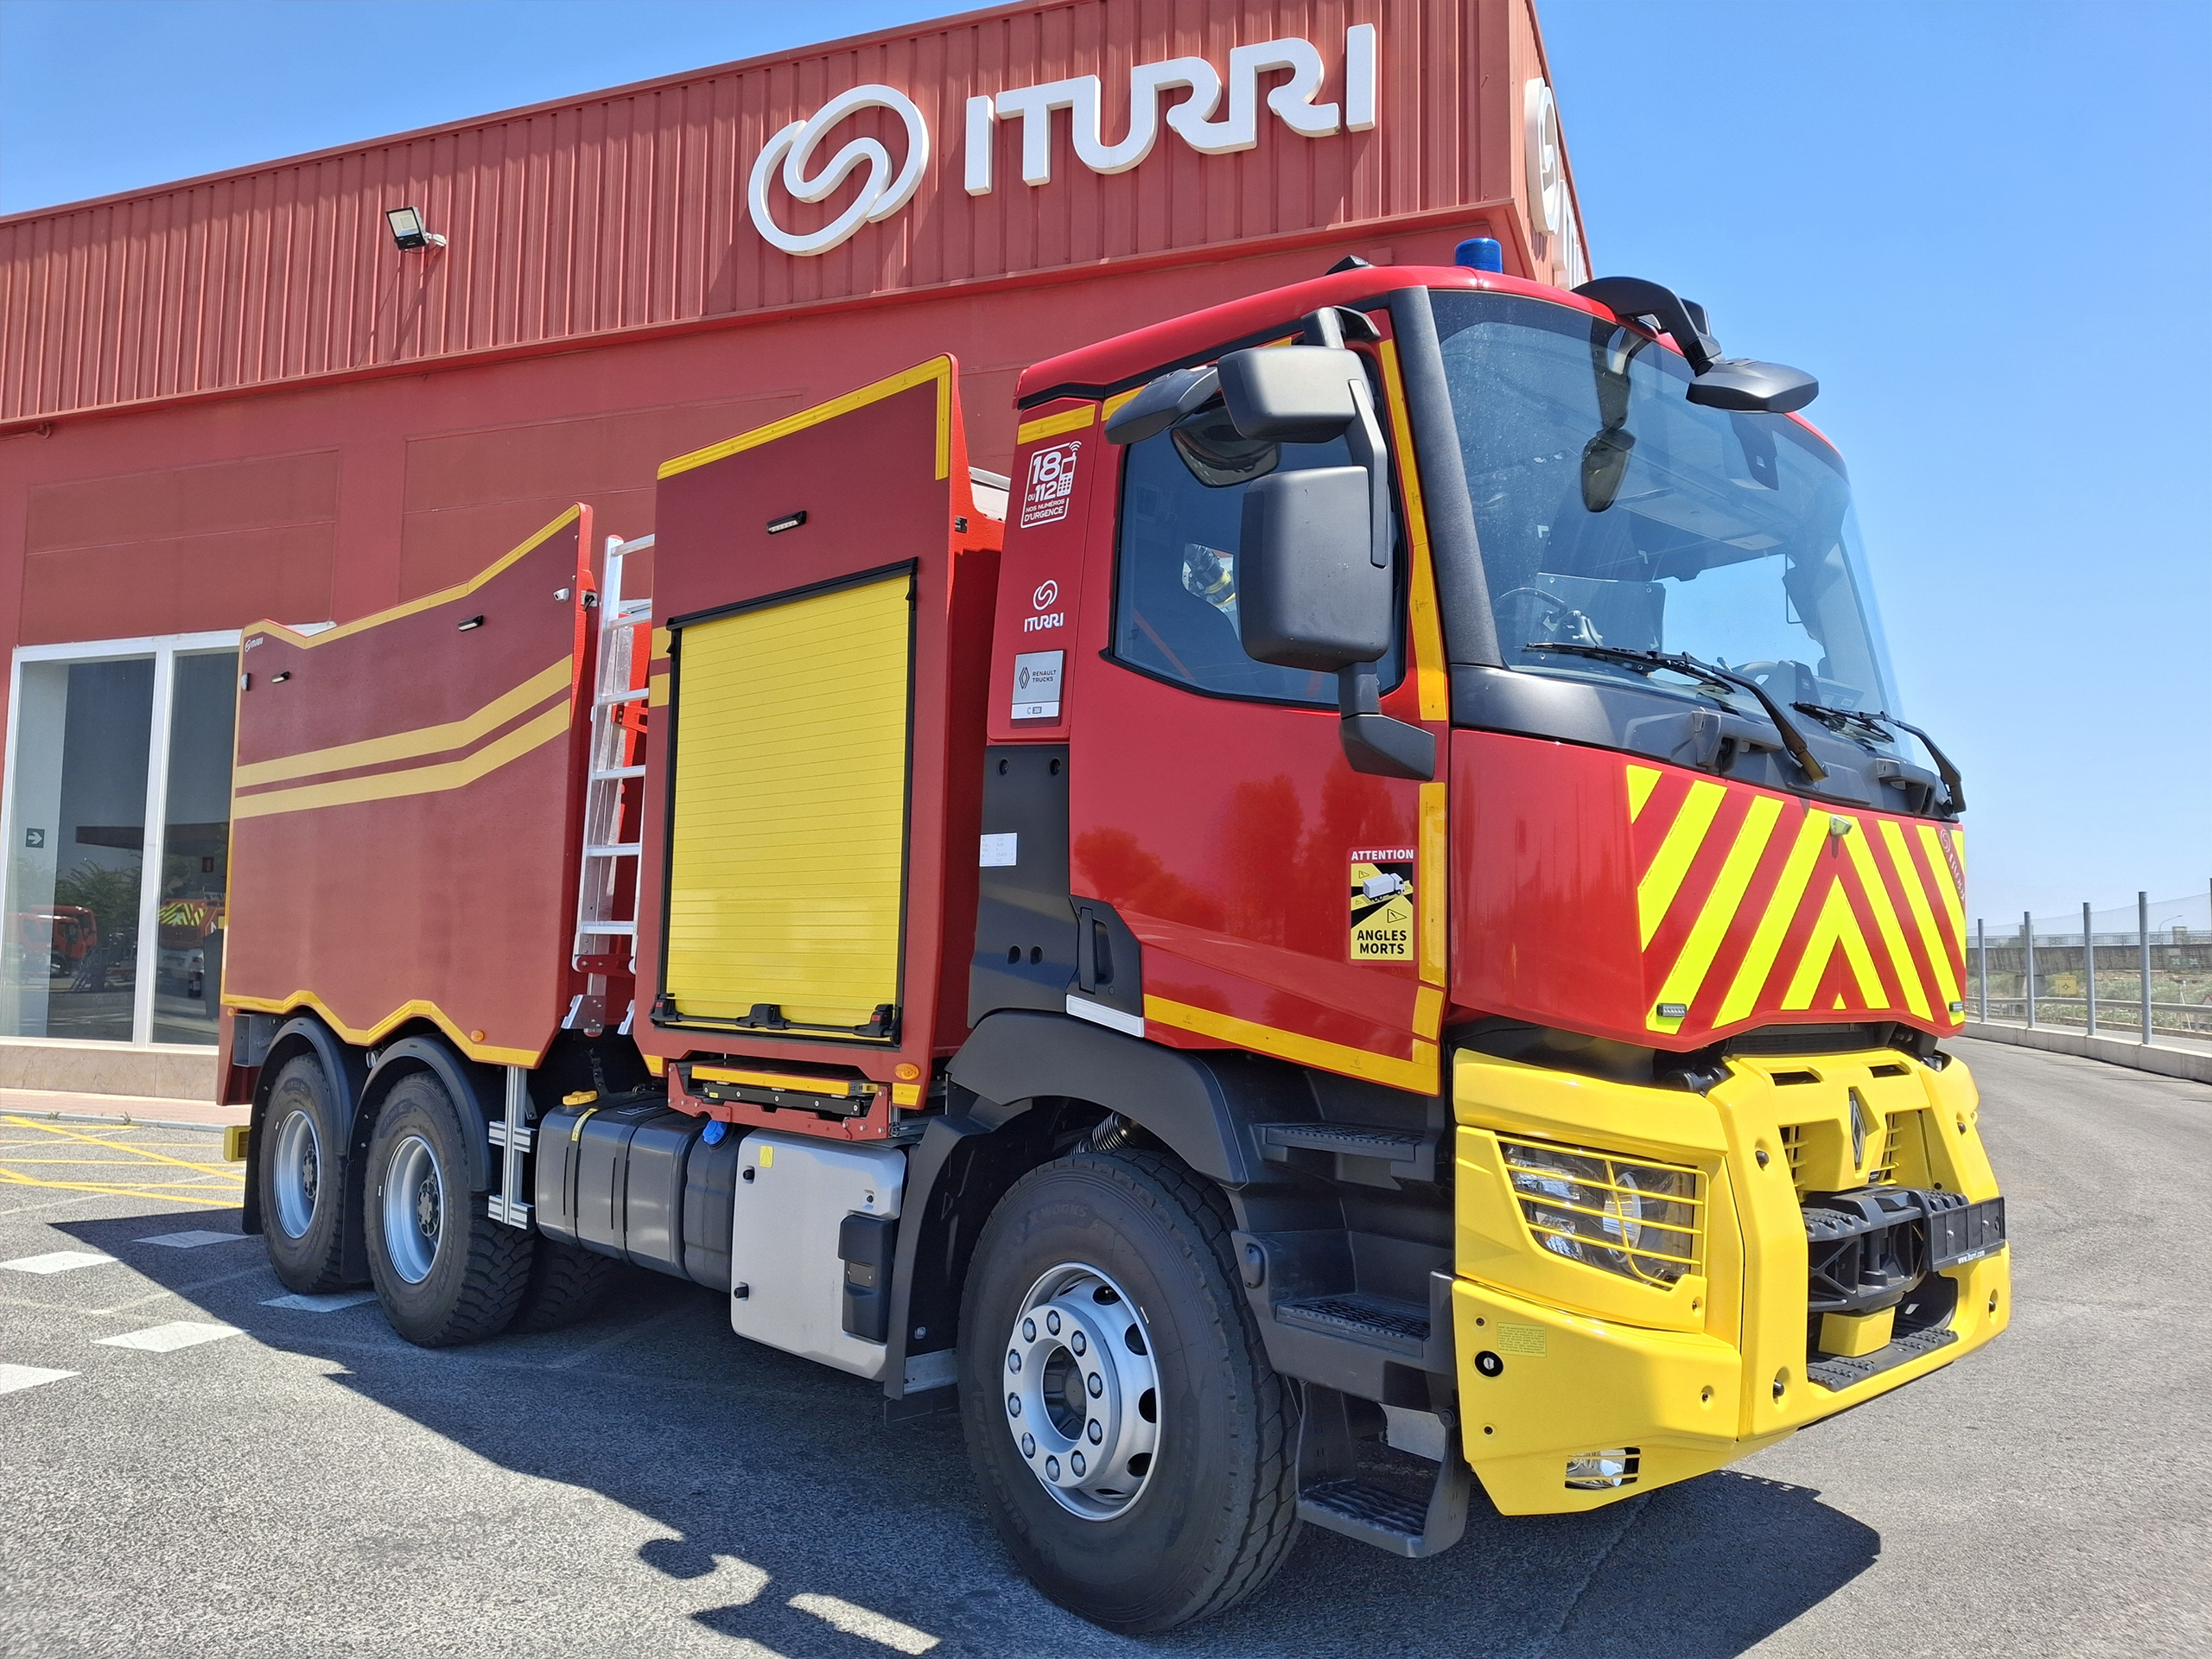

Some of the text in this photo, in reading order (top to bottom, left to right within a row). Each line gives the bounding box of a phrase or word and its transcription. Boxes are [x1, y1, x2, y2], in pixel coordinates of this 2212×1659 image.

[964, 23, 1376, 196] ITURRI
[1033, 451, 1062, 484] 18
[1034, 481, 1058, 502] 112
[1038, 499, 1065, 510] NUMÉROS
[1024, 506, 1064, 522] D'URGENCE
[1024, 612, 1064, 632] ITURRI
[1351, 849, 1414, 861] ATTENTION
[1357, 930, 1407, 941] ANGLES
[1359, 944, 1405, 954] MORTS
